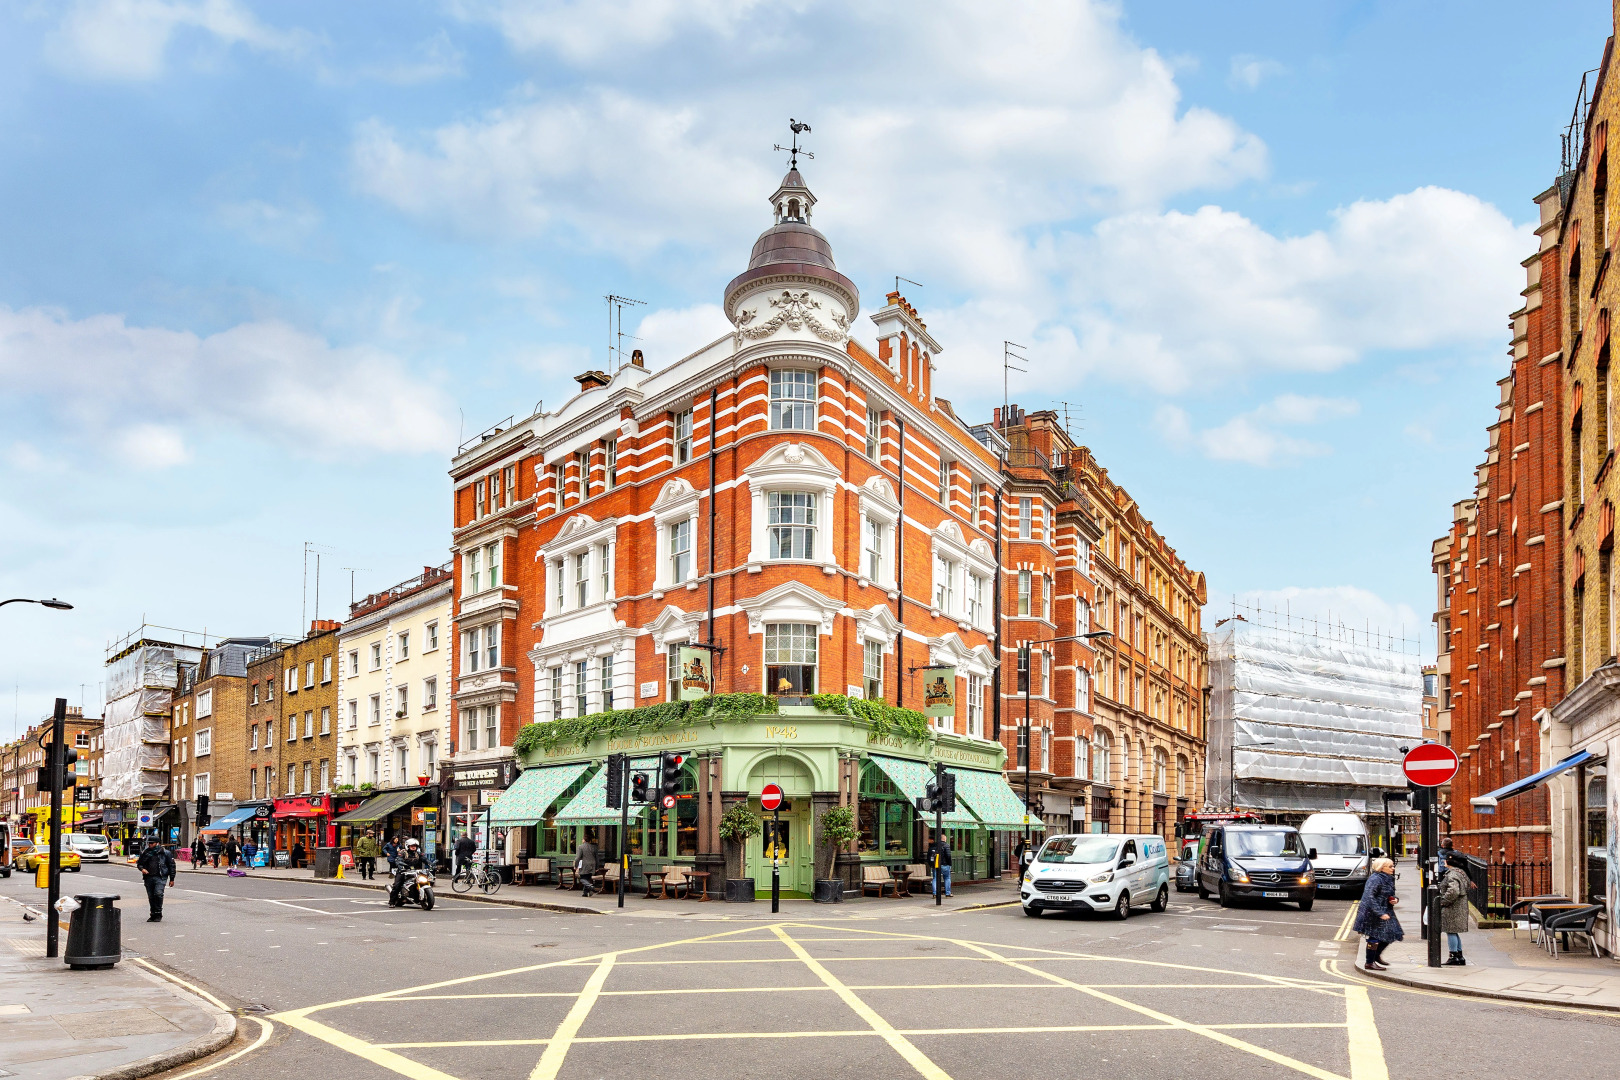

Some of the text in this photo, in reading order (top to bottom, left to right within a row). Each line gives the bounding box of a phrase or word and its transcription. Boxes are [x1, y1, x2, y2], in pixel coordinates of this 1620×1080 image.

[607, 739, 633, 751] HOUSE
[642, 730, 698, 748] BOTANICALS
[934, 744, 953, 758] HOUSE
[960, 751, 990, 765] BOTANICALS
